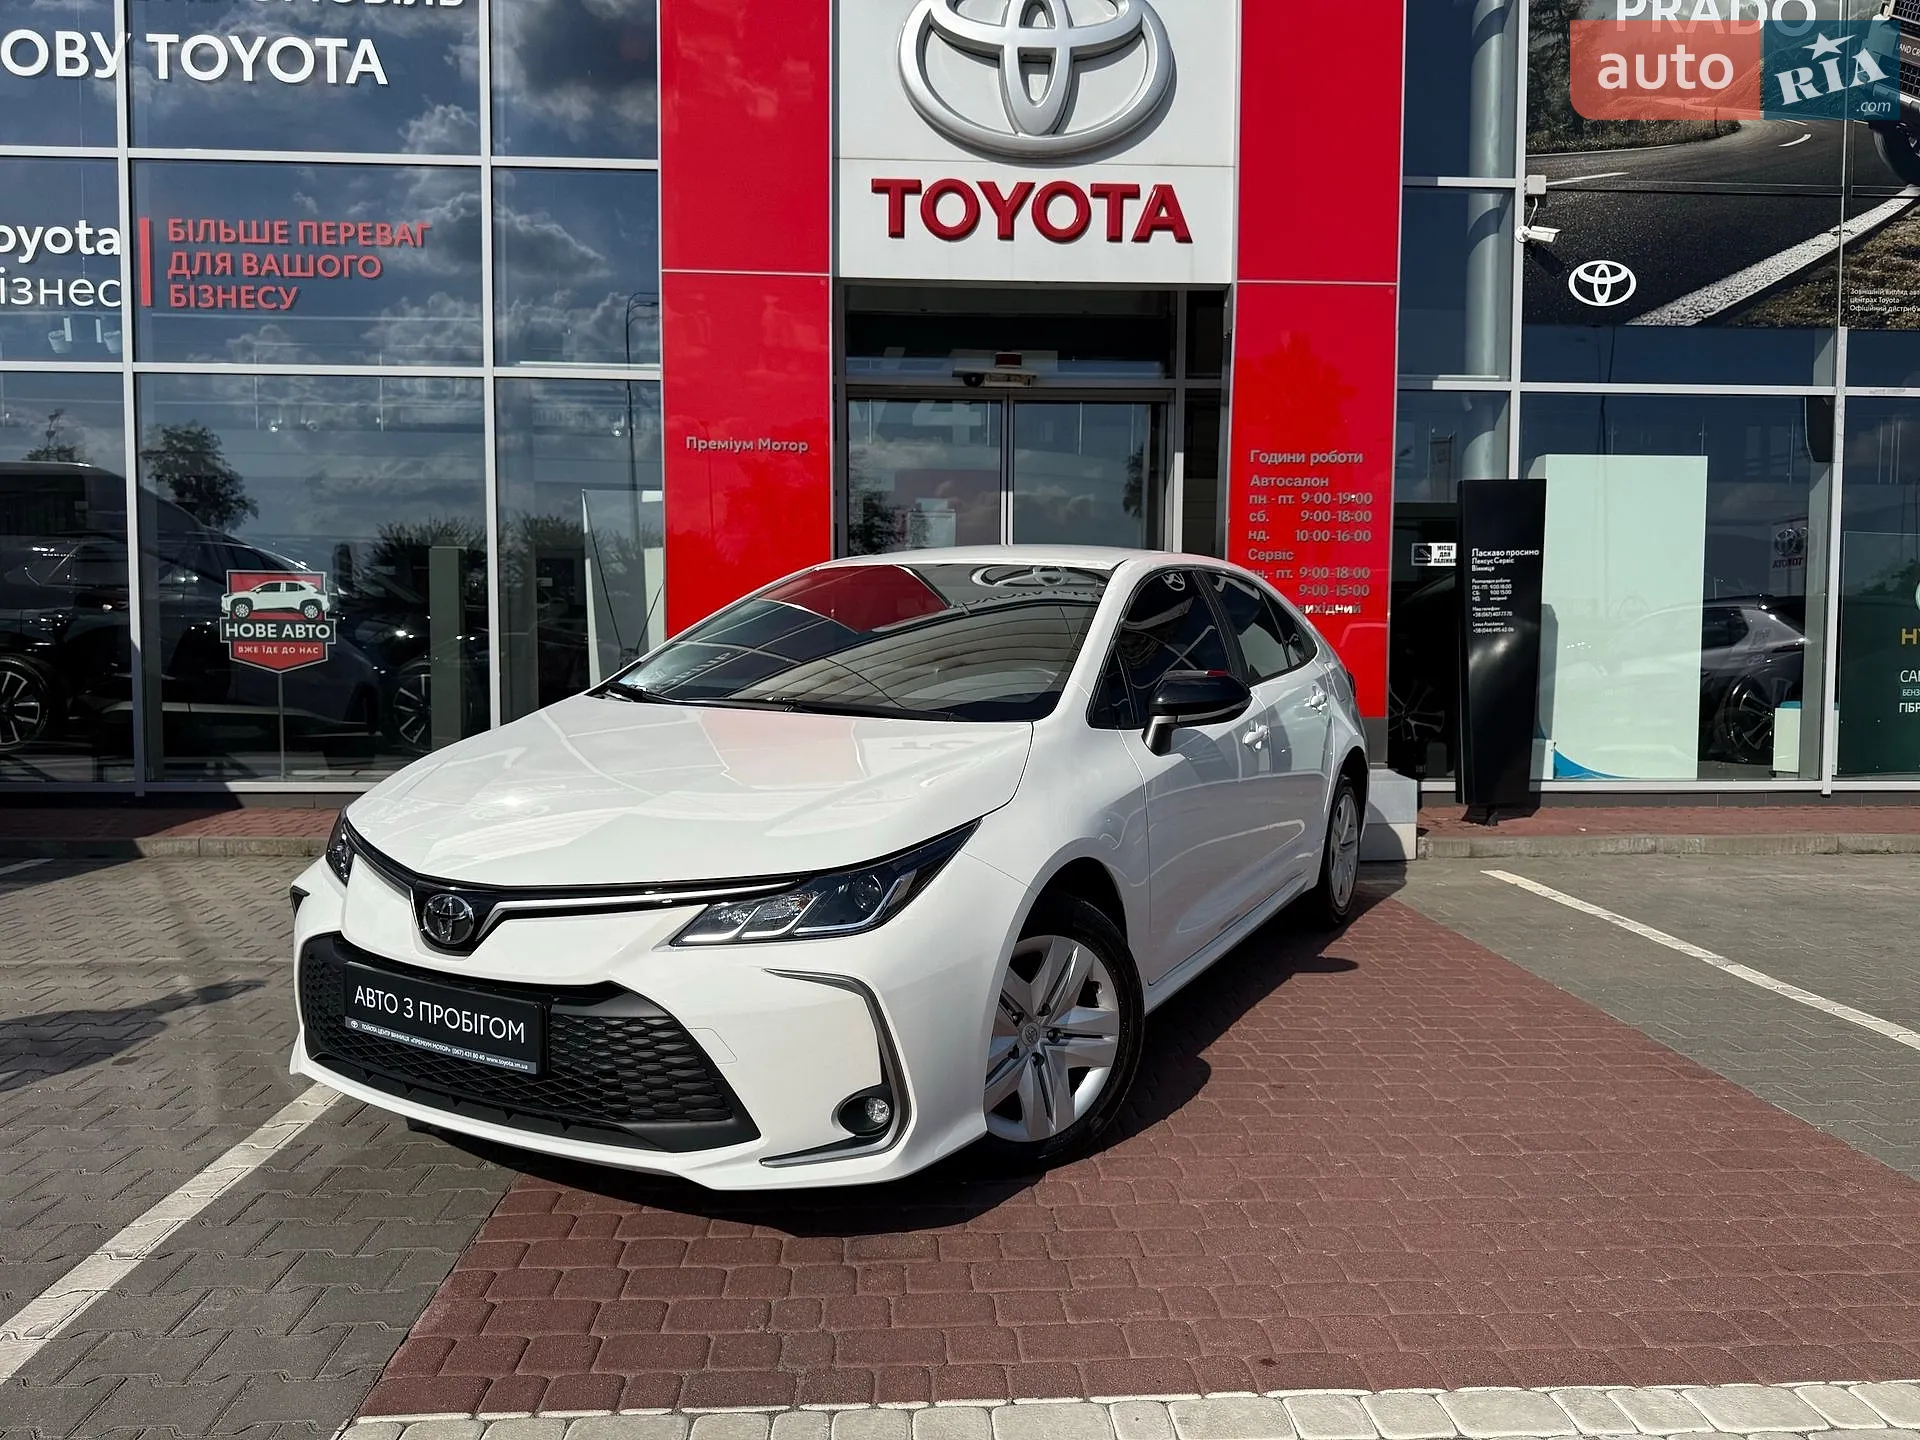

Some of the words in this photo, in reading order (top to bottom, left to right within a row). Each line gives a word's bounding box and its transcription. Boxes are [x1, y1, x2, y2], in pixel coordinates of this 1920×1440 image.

[1616, 0, 1816, 37] PRADO
[146, 34, 388, 84] TOYOTA
[871, 178, 1193, 244] TOYOTA
[167, 218, 289, 244] БІЛЬШЕ
[299, 221, 431, 248] ПЕРЕВАГ
[167, 251, 232, 279] ДЛЯ
[242, 253, 382, 278] ВАШОГО
[0, 267, 121, 307] ізнес
[170, 284, 298, 310] БІЗНЕСУ
[686, 436, 753, 452] Преміум
[758, 438, 808, 453] Мотор
[1250, 450, 1305, 464] Години
[1310, 449, 1363, 466] роботи
[1250, 475, 1329, 487] Автосалон
[1249, 510, 1270, 522] сб.
[1248, 530, 1270, 542] нд.
[1248, 548, 1294, 562] Сервіс
[1472, 548, 1505, 557] Ласкаво
[1506, 550, 1540, 558] просимо
[226, 623, 277, 638] НОВЕ
[281, 623, 330, 639] АВТО
[281, 646, 296, 655] ДО
[299, 646, 319, 654] НАС
[354, 985, 399, 1014] АВТО
[419, 1001, 525, 1044] ПРОБІГОМ
